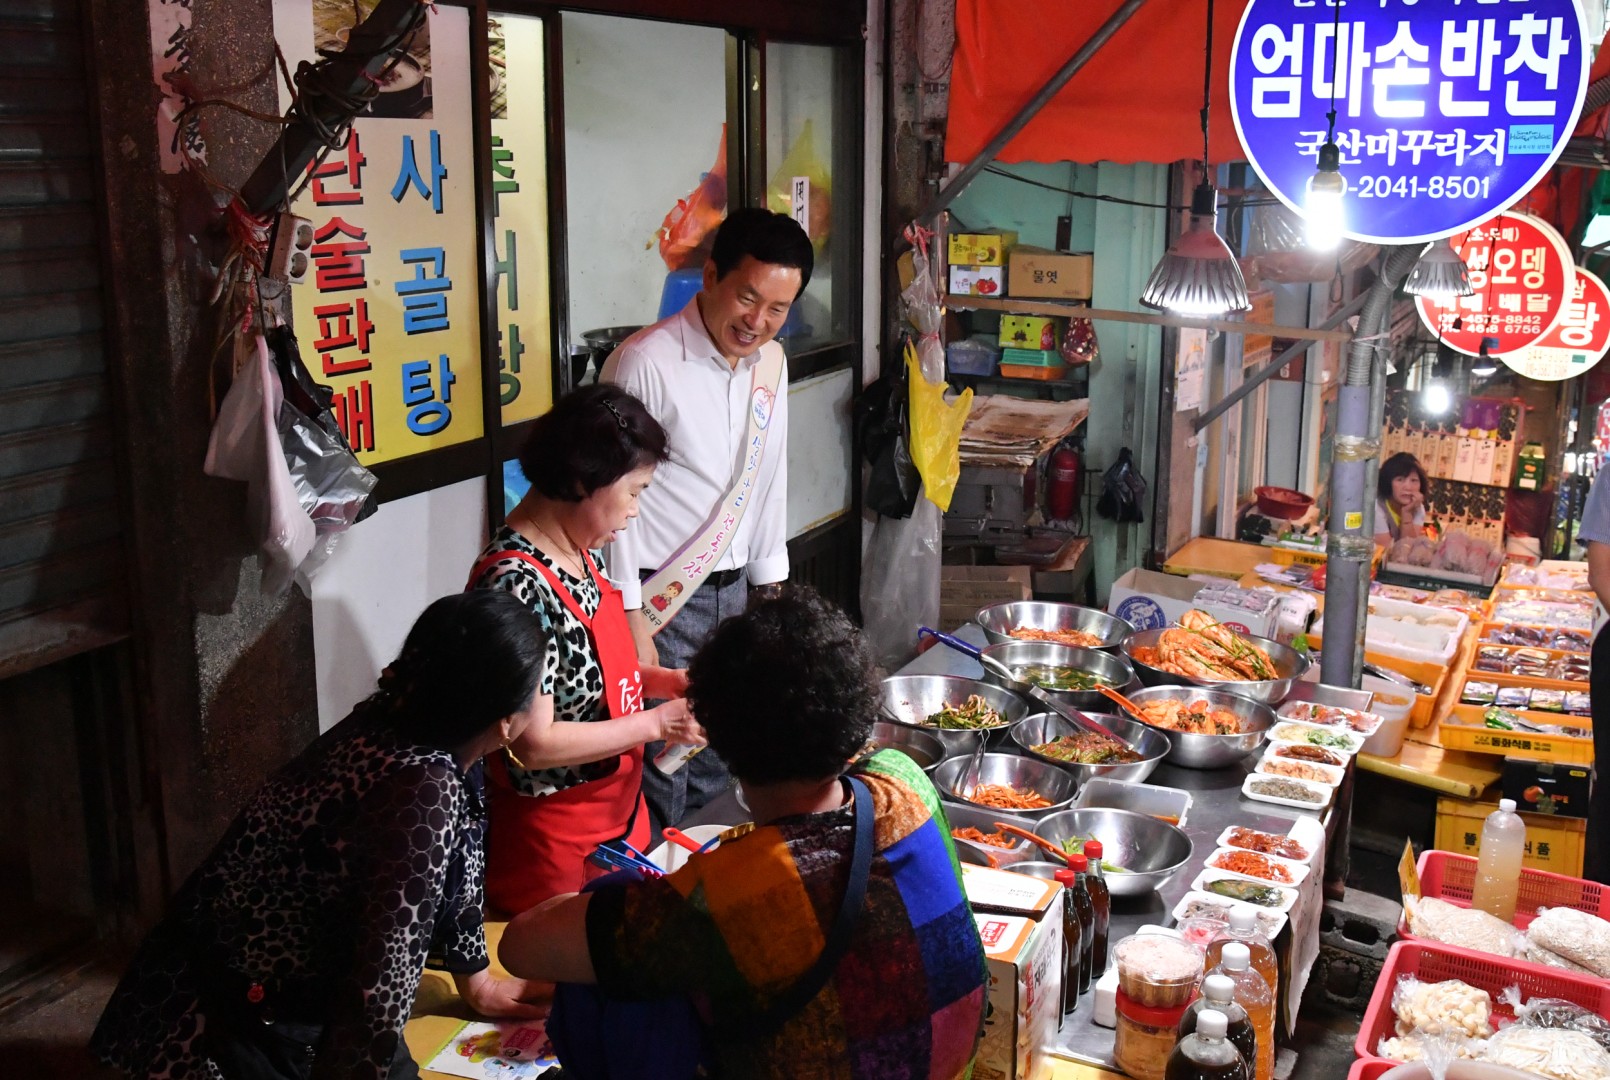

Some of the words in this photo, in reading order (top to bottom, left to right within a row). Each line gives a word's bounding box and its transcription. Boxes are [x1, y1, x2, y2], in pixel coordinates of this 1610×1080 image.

[1251, 13, 1568, 117] 엄마손반찬
[389, 129, 456, 438] 사골탕
[1033, 270, 1058, 284] 물엿
[1455, 245, 1547, 290] 성오뎅
[1504, 325, 1541, 335] 6756
[682, 513, 735, 579] 전통시장
[1491, 736, 1532, 750] 동화식품
